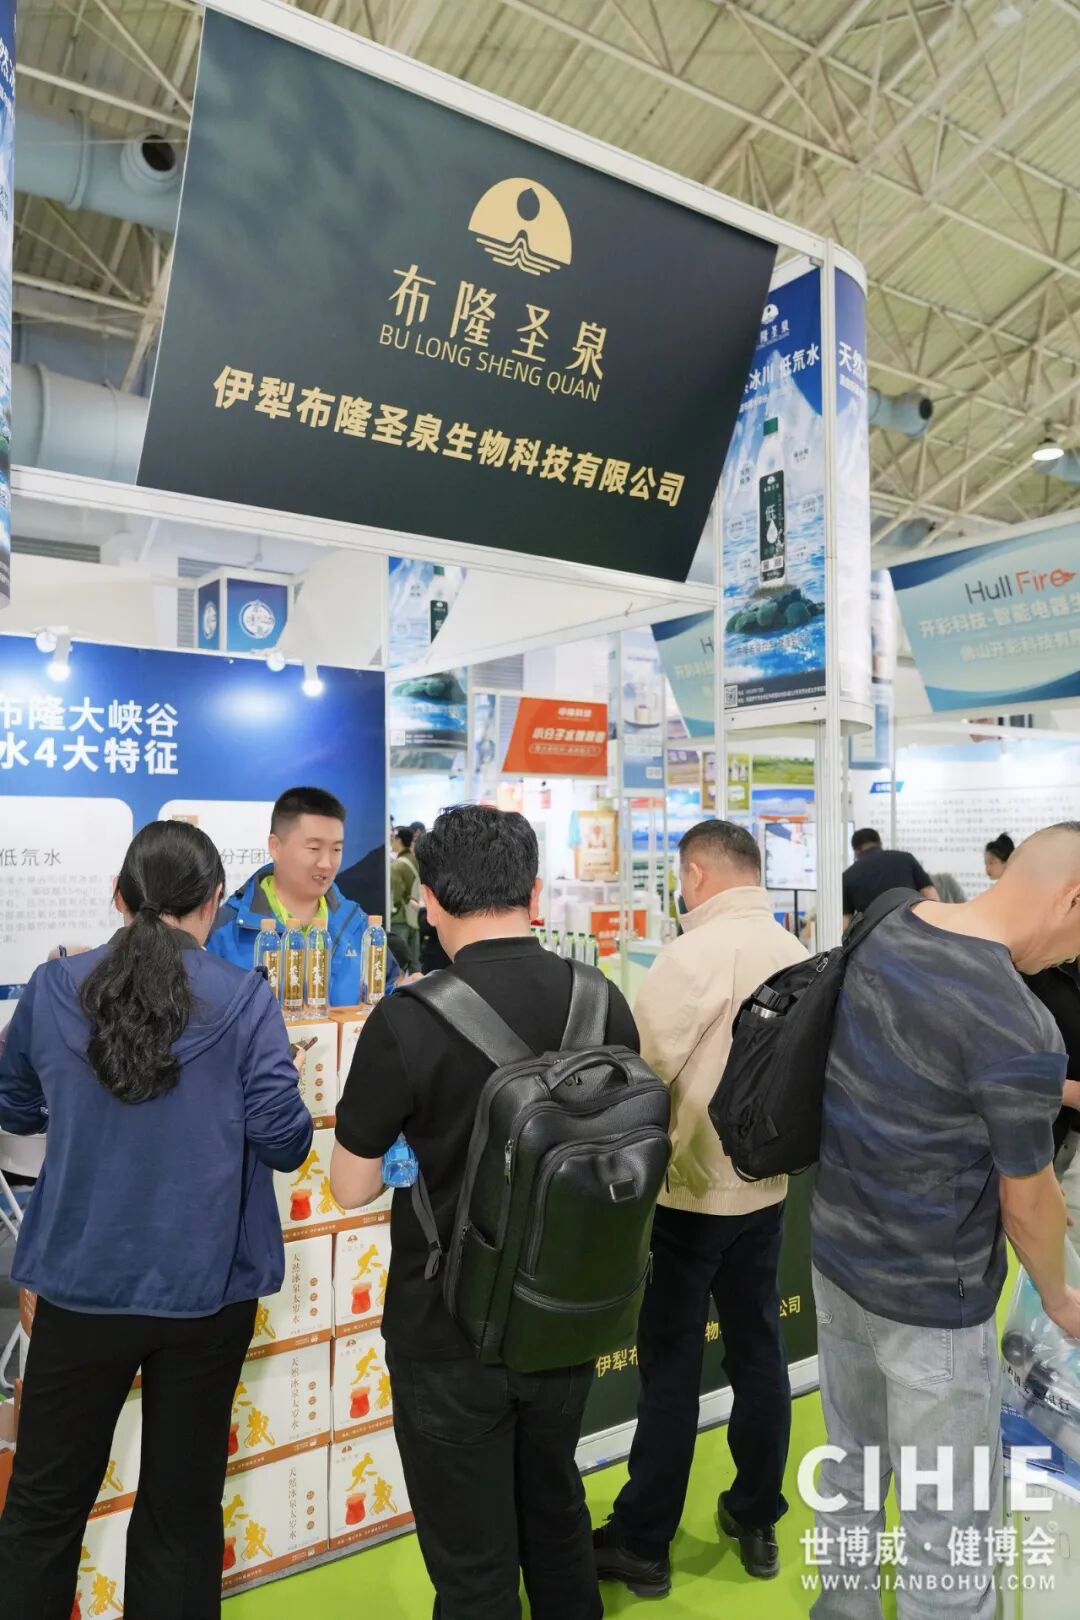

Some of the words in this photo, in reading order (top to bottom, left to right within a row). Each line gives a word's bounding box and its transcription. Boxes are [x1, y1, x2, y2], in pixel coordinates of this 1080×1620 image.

[389, 264, 608, 380] 布隆圣泉
[379, 324, 407, 350] BU
[415, 338, 471, 367] LONG
[476, 352, 542, 387] SHENG
[546, 371, 601, 402] QUAN
[213, 366, 686, 508] 伊犁布隆圣泉生物科技有限公司
[964, 575, 1013, 604] Hull
[1015, 568, 1070, 594] Fire
[0, 732, 179, 775] 水4大特征
[705, 1321, 722, 1342] 物
